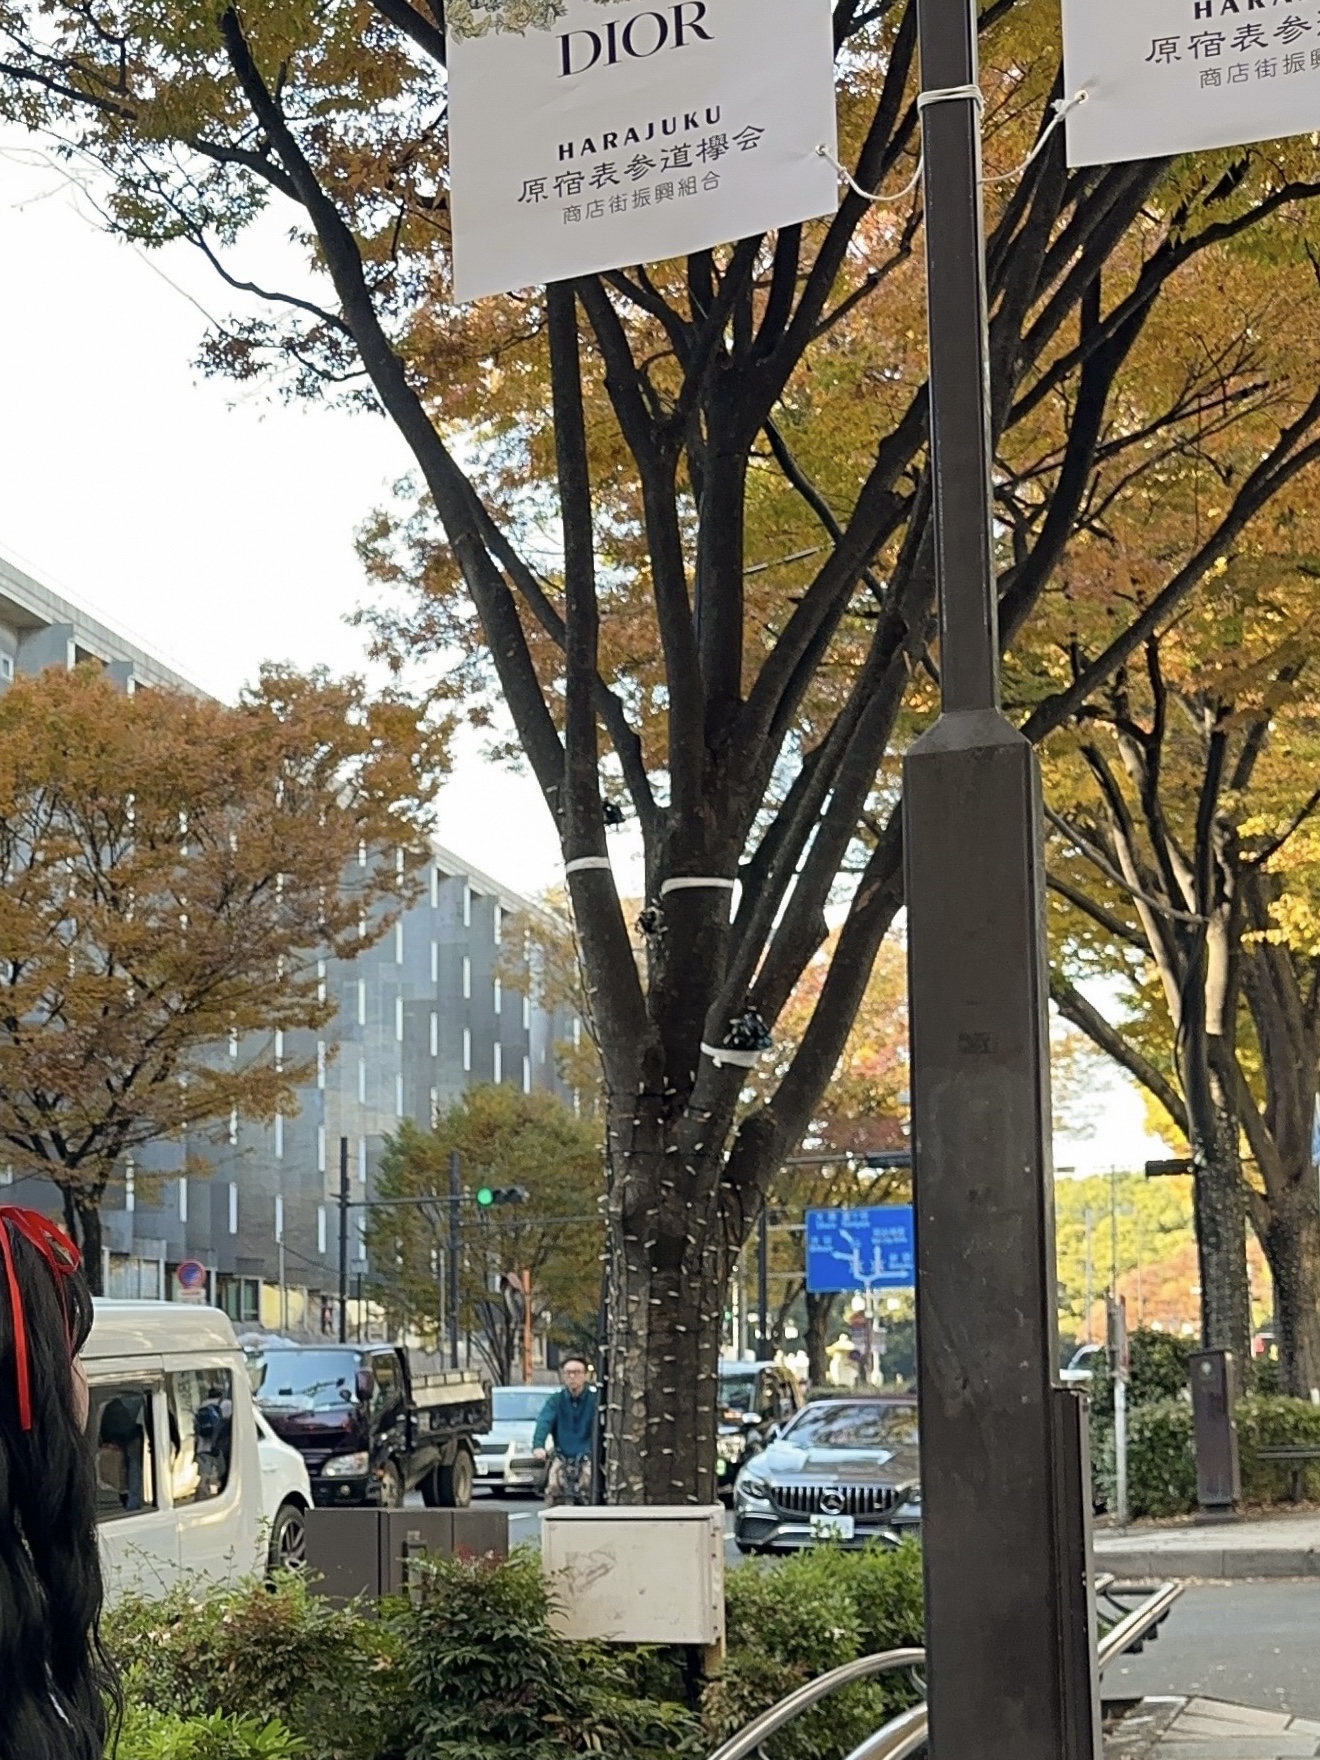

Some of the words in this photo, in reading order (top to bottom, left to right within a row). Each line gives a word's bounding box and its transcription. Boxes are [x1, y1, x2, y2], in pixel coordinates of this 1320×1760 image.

[1144, 10, 1320, 65] 原宿表参
[1194, 0, 1294, 20] HAR
[556, 1, 715, 78] DIOR
[558, 105, 721, 162] HARAJUKU
[518, 125, 766, 204] 原宿表参道欅会
[562, 170, 721, 225] 商店街振興組合
